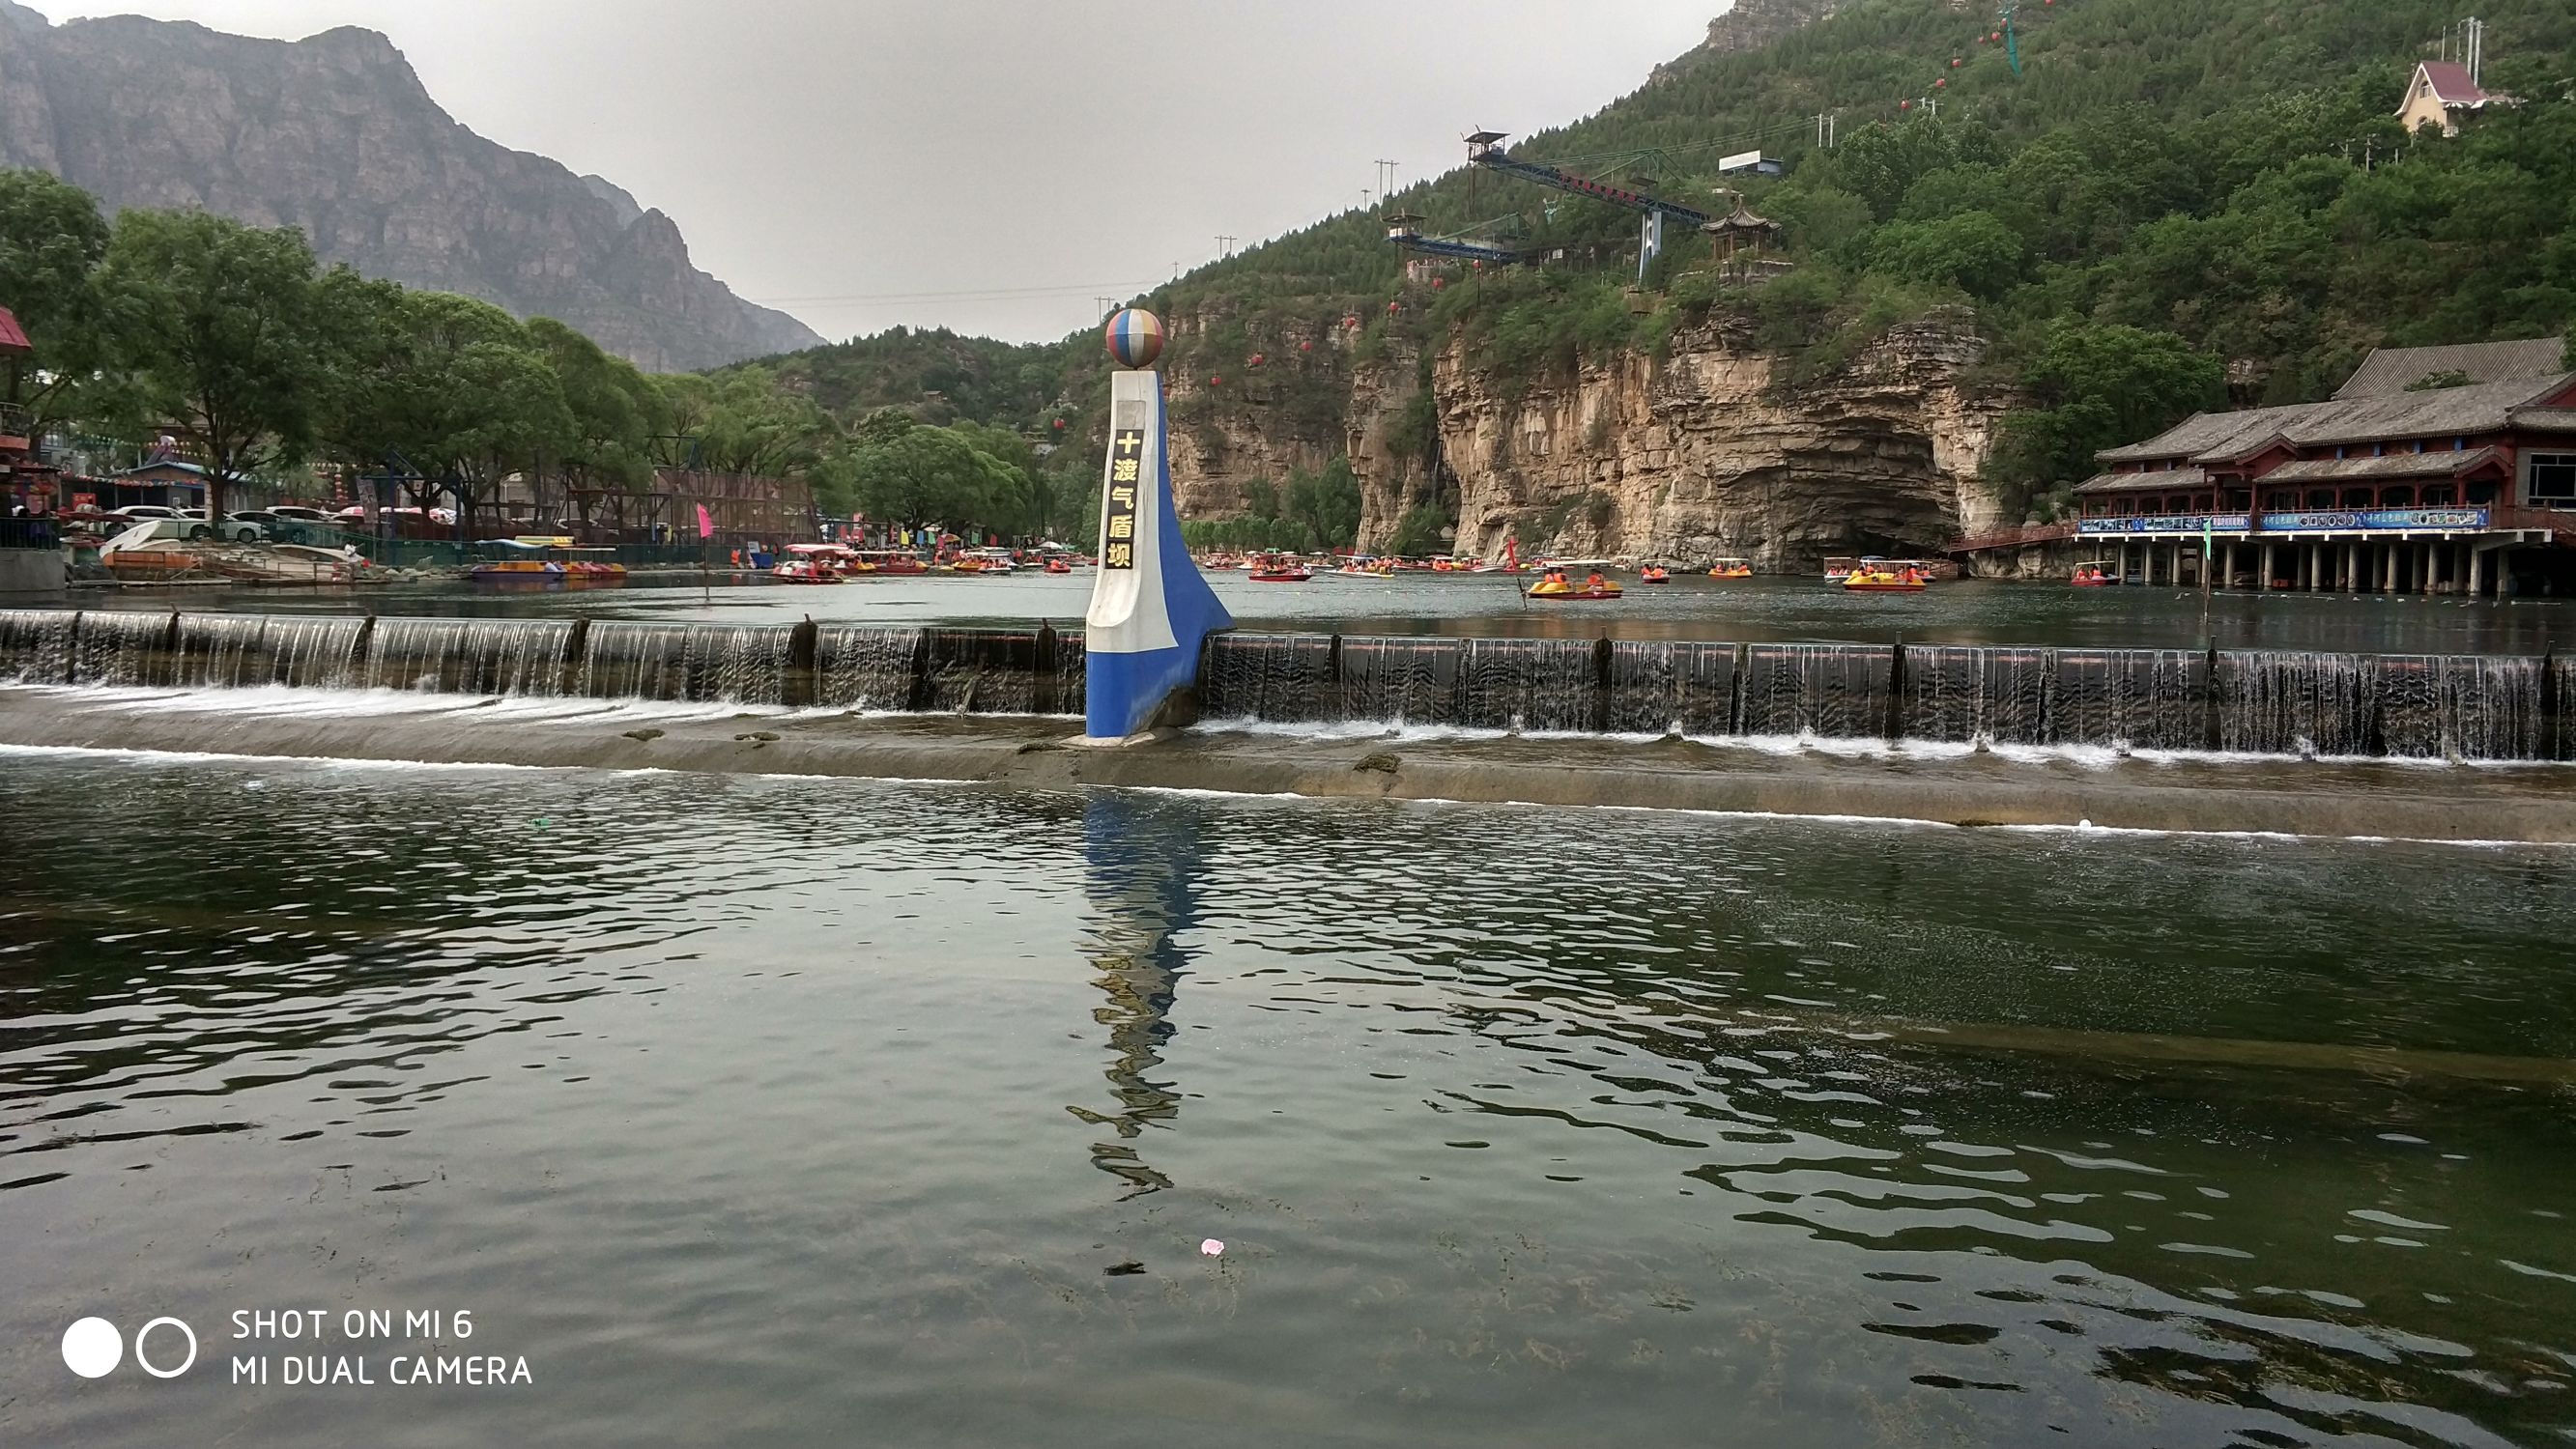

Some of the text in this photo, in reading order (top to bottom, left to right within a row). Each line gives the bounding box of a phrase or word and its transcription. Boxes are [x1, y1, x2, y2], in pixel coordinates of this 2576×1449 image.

[1107, 431, 1141, 568] 十渡气盾坝
